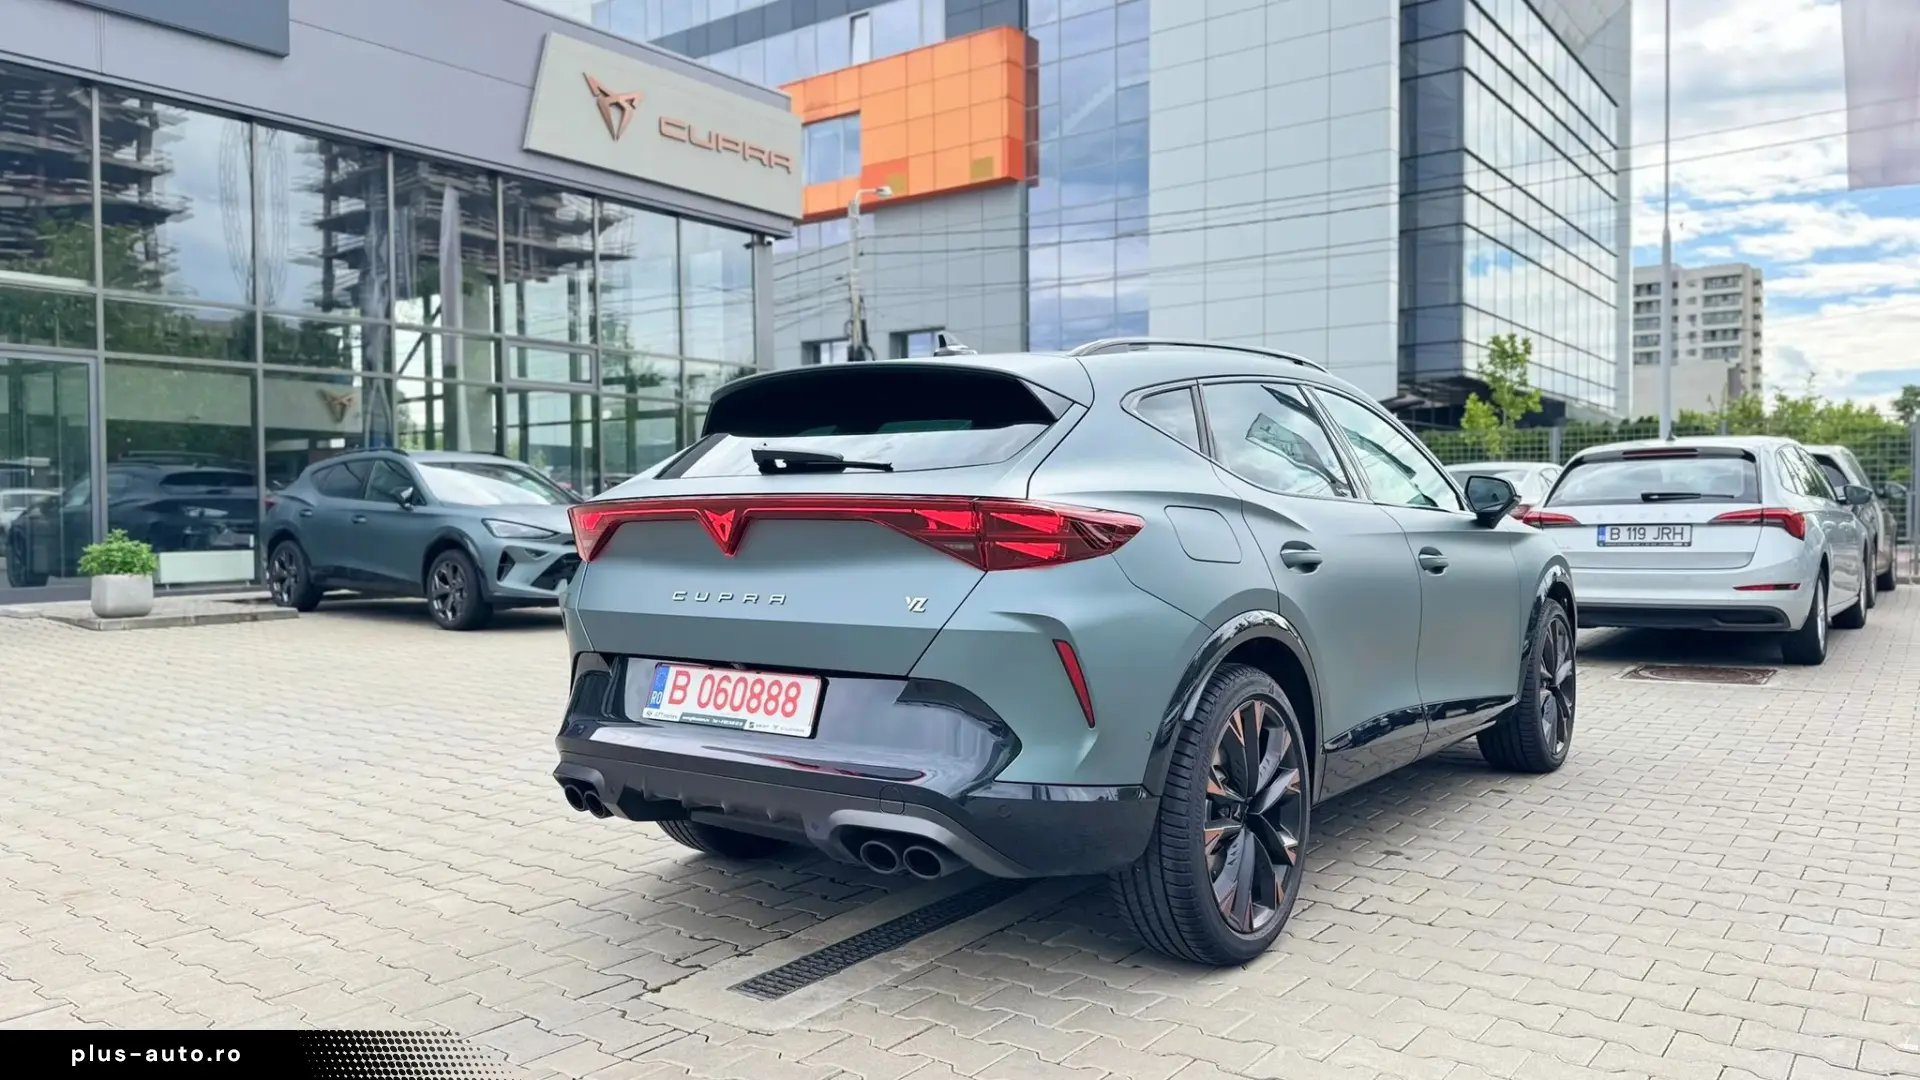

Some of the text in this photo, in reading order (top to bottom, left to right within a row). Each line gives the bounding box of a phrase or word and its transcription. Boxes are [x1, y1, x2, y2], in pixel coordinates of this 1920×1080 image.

[658, 116, 793, 174] CUPRA
[1609, 526, 1621, 540] B
[1626, 526, 1646, 540] 119
[1652, 526, 1684, 541] JRH
[672, 591, 786, 605] CUPRA
[905, 596, 928, 612] VZ
[650, 670, 801, 718] RO B 060888
